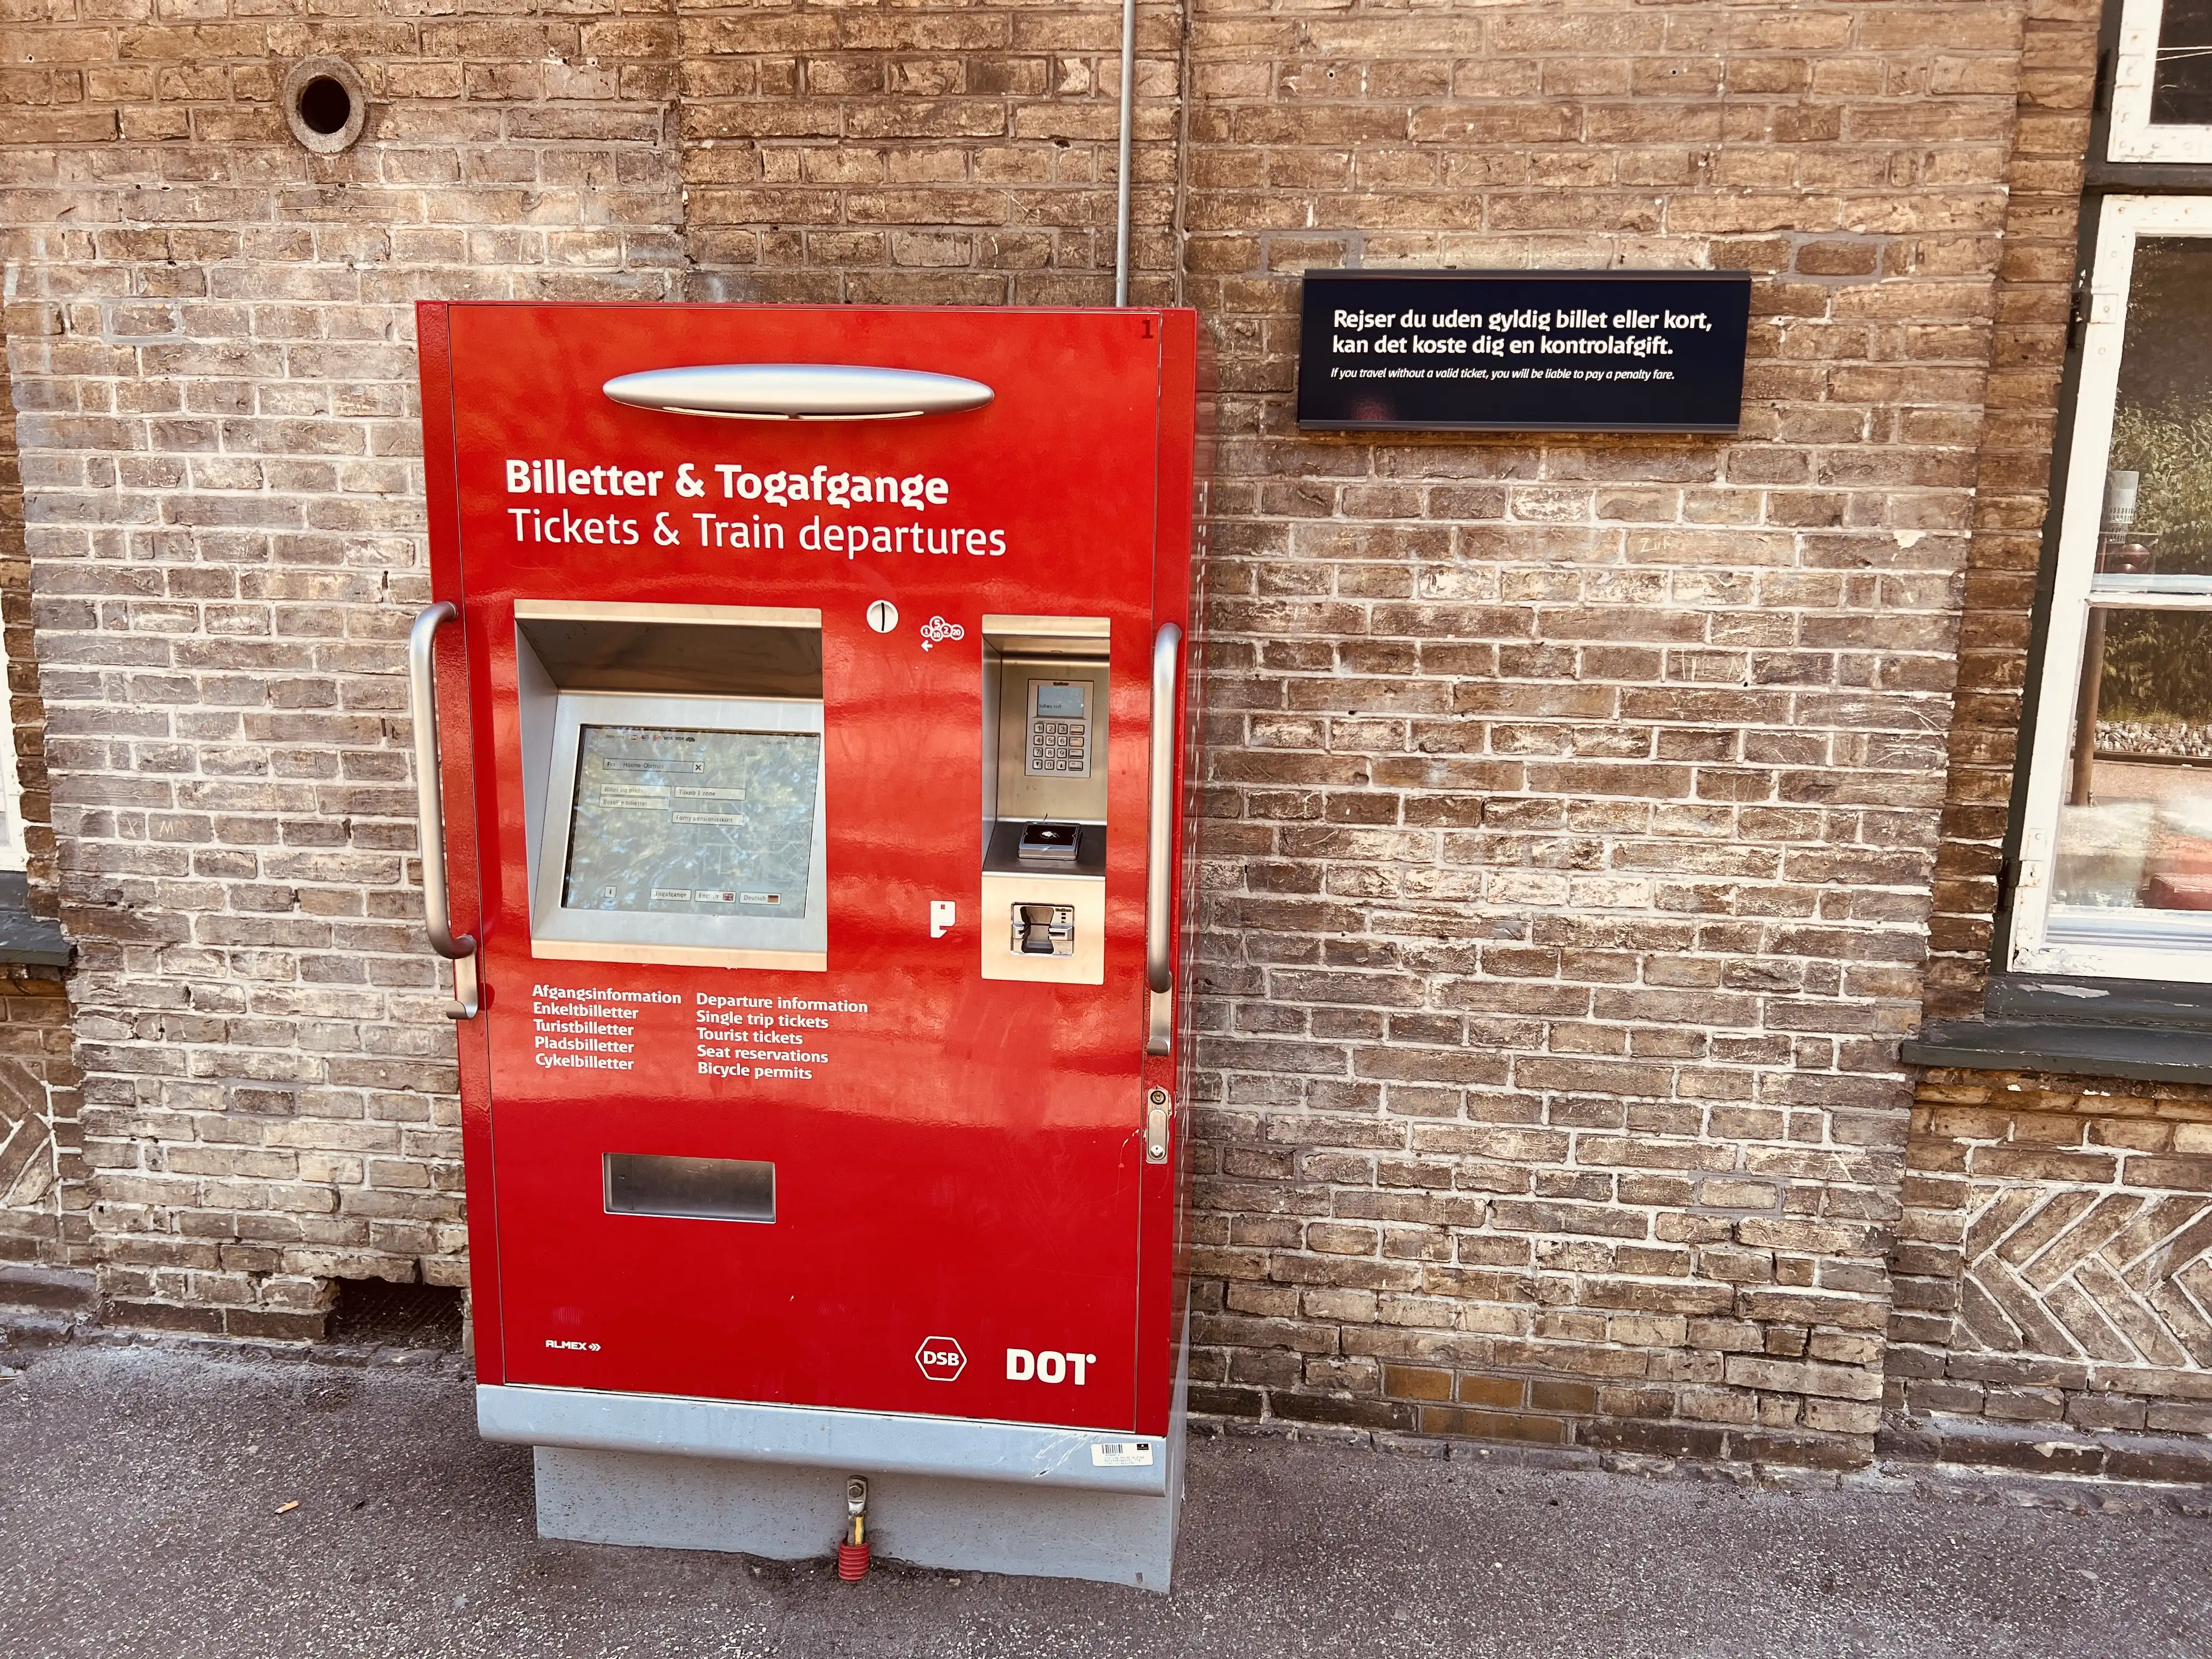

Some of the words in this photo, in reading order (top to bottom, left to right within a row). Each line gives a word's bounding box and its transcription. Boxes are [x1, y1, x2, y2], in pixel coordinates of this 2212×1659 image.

[1334, 309, 1396, 332] Rejser
[1400, 309, 1426, 328] du
[1432, 309, 1482, 328] uden
[1488, 309, 1551, 332] gyldig
[1556, 309, 1608, 329] billet
[1612, 309, 1660, 329] eller
[1664, 309, 1712, 332] kort,
[1333, 335, 1368, 353] kan
[1374, 335, 1408, 353] det
[1413, 335, 1467, 353] koste
[1472, 335, 1505, 357] dig
[1509, 340, 1534, 354] en
[1541, 335, 1673, 358] kontrolafgift.
[1330, 367, 1339, 378] If
[1339, 369, 1357, 380] you
[1359, 368, 1387, 378] travel
[1388, 368, 1425, 378] without
[1426, 369, 1432, 378] a
[1435, 368, 1459, 378] valid
[1460, 368, 1489, 380] ticket,
[1491, 370, 1509, 381] you
[1512, 368, 1529, 379] will
[1531, 368, 1543, 379] be
[1545, 368, 1571, 379] liable
[1573, 369, 1583, 379] to
[1585, 370, 1604, 381] pay
[1606, 370, 1612, 379] a
[1614, 369, 1651, 381] penalty
[1653, 369, 1675, 380] fare.
[506, 459, 664, 496] Billetter
[675, 463, 706, 498] &
[714, 464, 949, 511] Togafgange
[507, 508, 639, 545] Tickets
[653, 512, 680, 546] &
[692, 513, 784, 549] Train
[799, 515, 1006, 558] departures
[934, 619, 940, 628] 5
[532, 984, 681, 1004] Afgangsinformation
[696, 992, 773, 1009] Departure
[777, 996, 868, 1013] information
[533, 1002, 639, 1019] Enkeltbilletter
[696, 1009, 743, 1026] Single
[747, 1013, 774, 1029] trip
[778, 1014, 829, 1029] tickets
[533, 1019, 634, 1036] Turistbilletter
[696, 1027, 749, 1042] Tourist
[752, 1030, 803, 1045] tickets
[534, 1036, 635, 1053] Pladsbilletter
[535, 1053, 635, 1070] Cykelbilletter
[697, 1045, 731, 1058] Seat
[735, 1049, 828, 1063] reservations
[698, 1062, 750, 1078] Bicycle
[754, 1066, 812, 1080] permits
[545, 1339, 588, 1351] ALMEX
[923, 1350, 960, 1367] DSB
[1006, 1348, 1086, 1385] DOT
